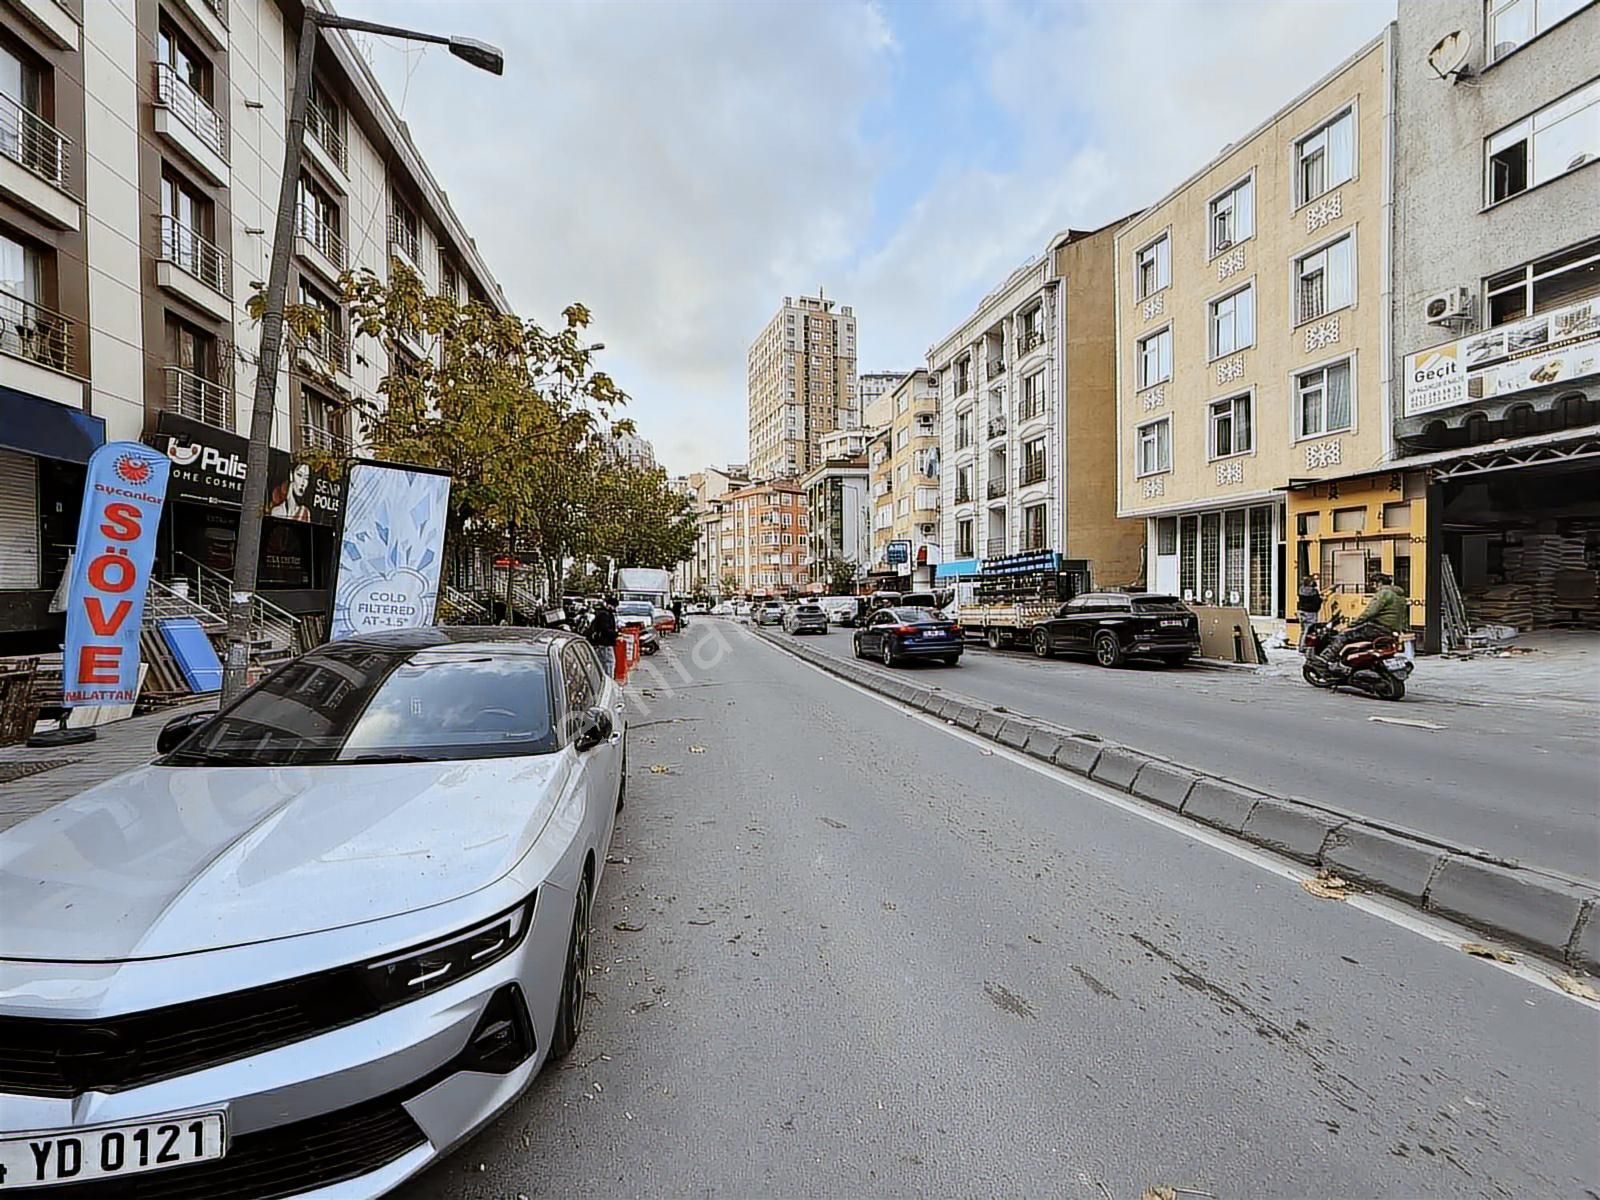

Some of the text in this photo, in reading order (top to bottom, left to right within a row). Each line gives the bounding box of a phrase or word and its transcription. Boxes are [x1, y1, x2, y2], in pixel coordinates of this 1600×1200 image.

[1415, 361, 1457, 383] Geçit
[173, 469, 243, 491] OME COSME
[78, 502, 143, 684] SÖVE
[369, 592, 407, 603] COLD
[358, 603, 416, 616] FILTERED
[30, 1137, 83, 1181] YD
[100, 1120, 204, 1172] 0121
